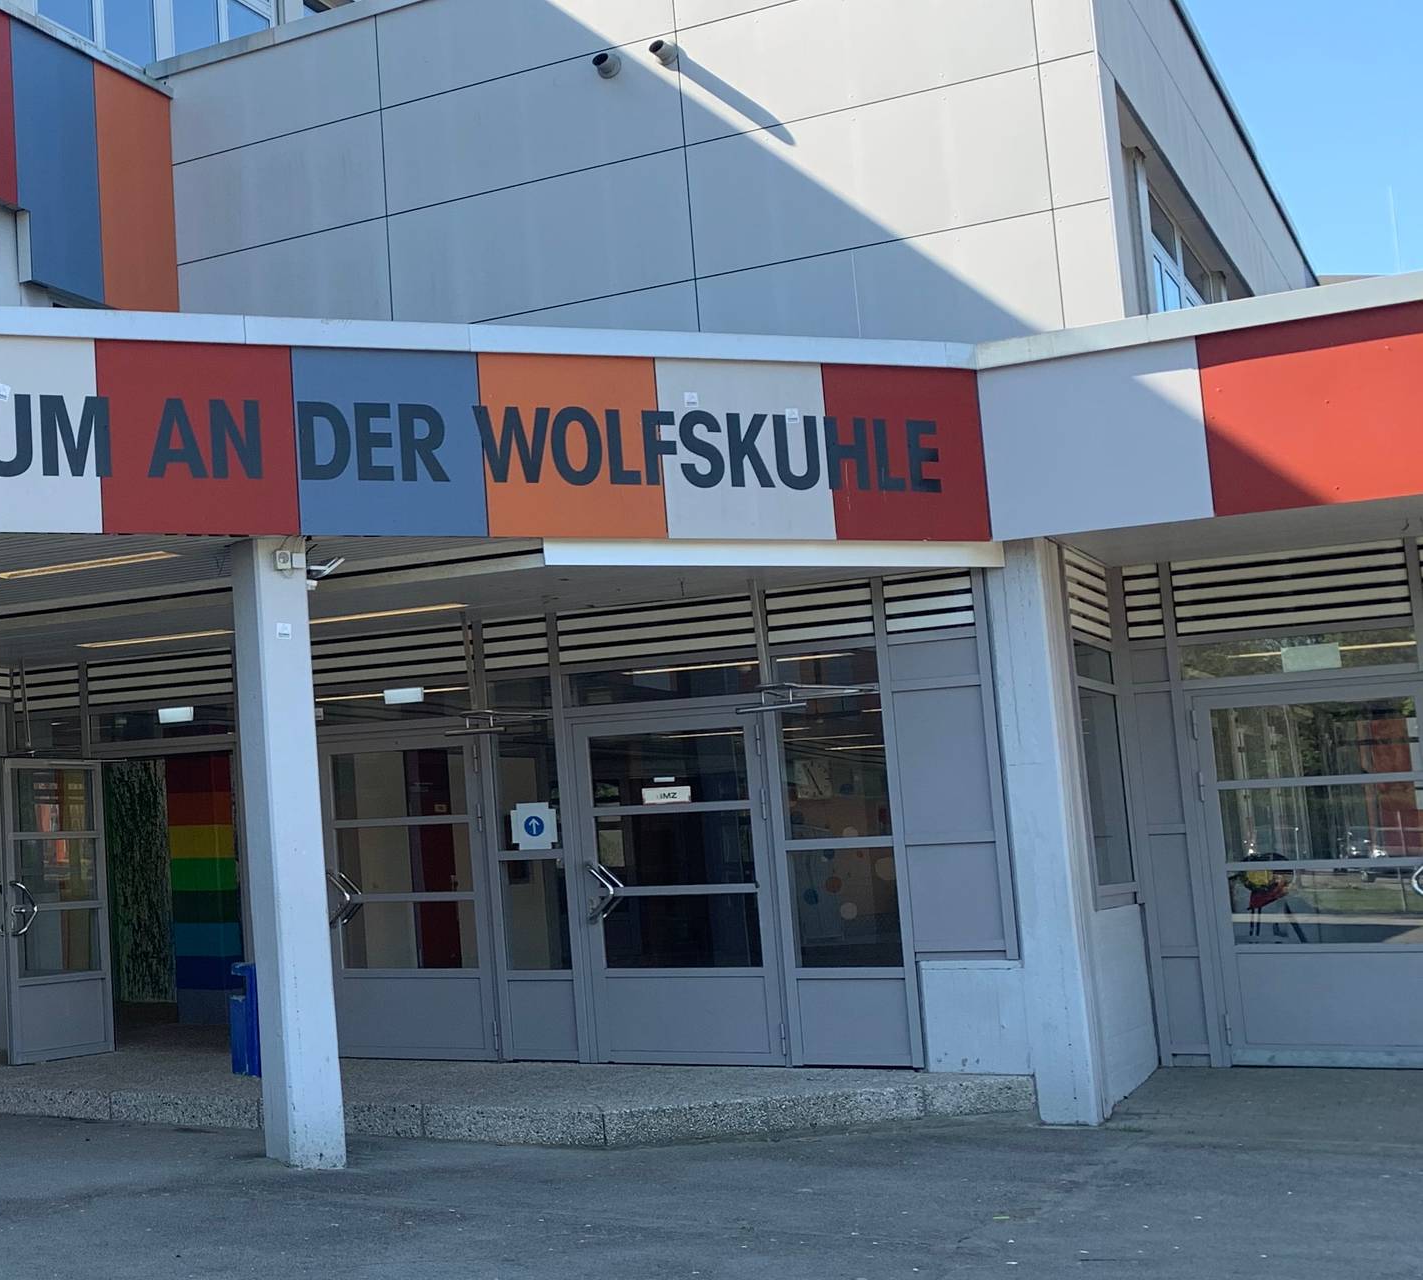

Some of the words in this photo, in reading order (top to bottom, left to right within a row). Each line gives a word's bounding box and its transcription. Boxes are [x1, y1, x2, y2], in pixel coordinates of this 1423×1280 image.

[147, 397, 264, 480] AN
[296, 400, 451, 482] DER
[471, 405, 943, 493] WOLFSKUHLE
